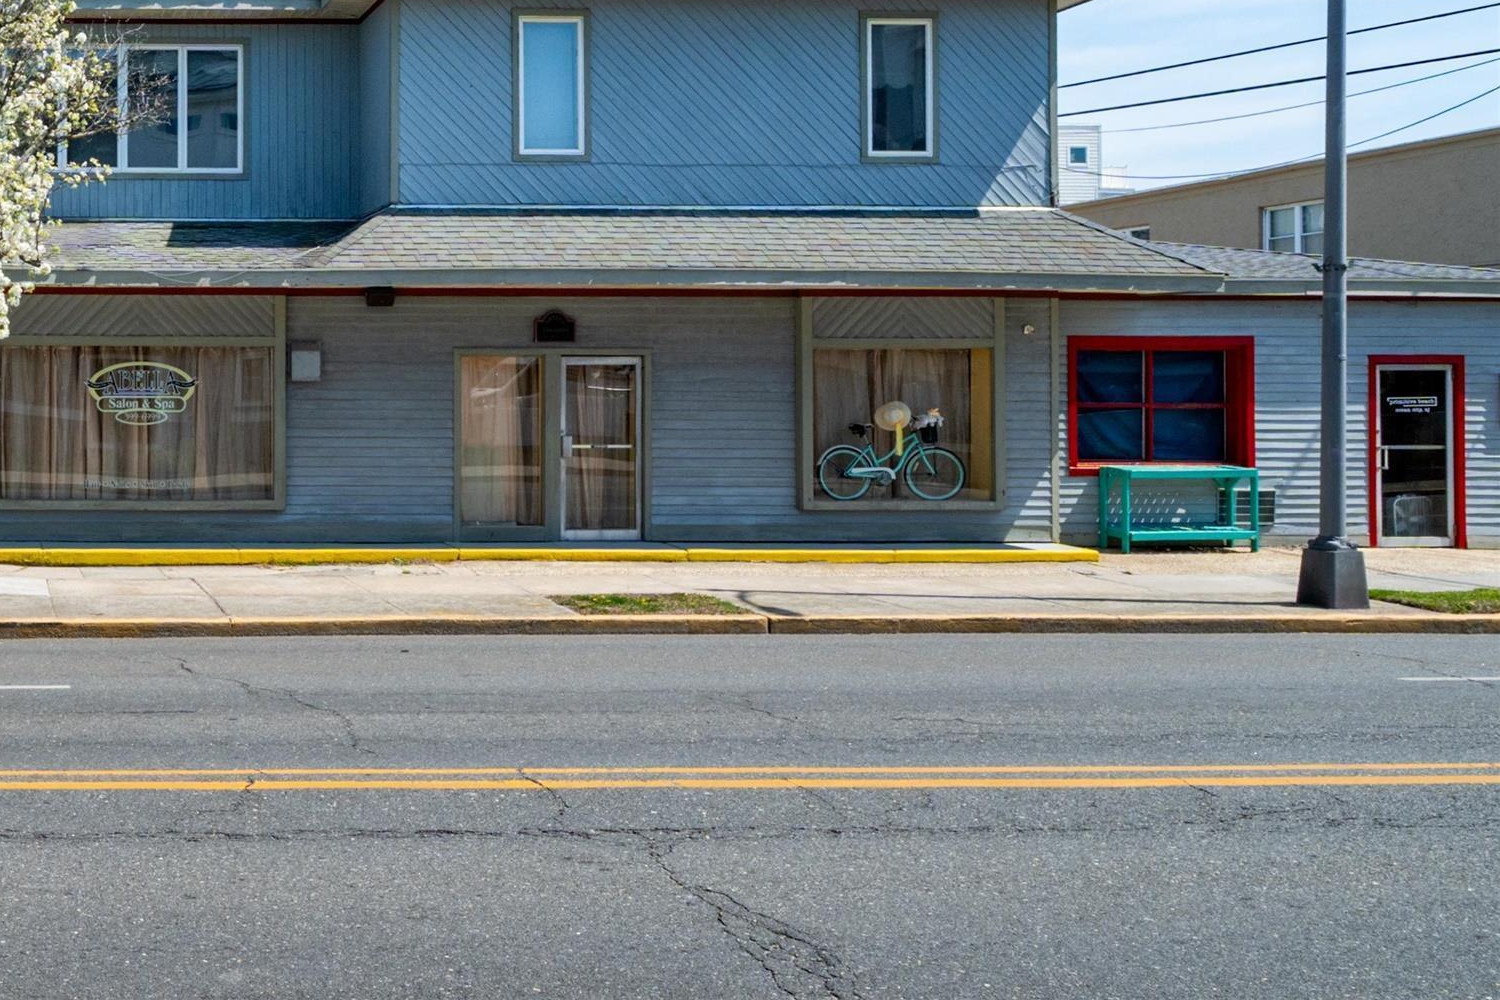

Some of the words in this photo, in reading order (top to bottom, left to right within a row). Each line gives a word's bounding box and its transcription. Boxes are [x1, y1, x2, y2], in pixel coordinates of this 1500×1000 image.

[103, 369, 180, 395] ABELLA
[108, 398, 139, 409] Salon
[141, 398, 151, 409] &
[153, 398, 175, 410] Spa
